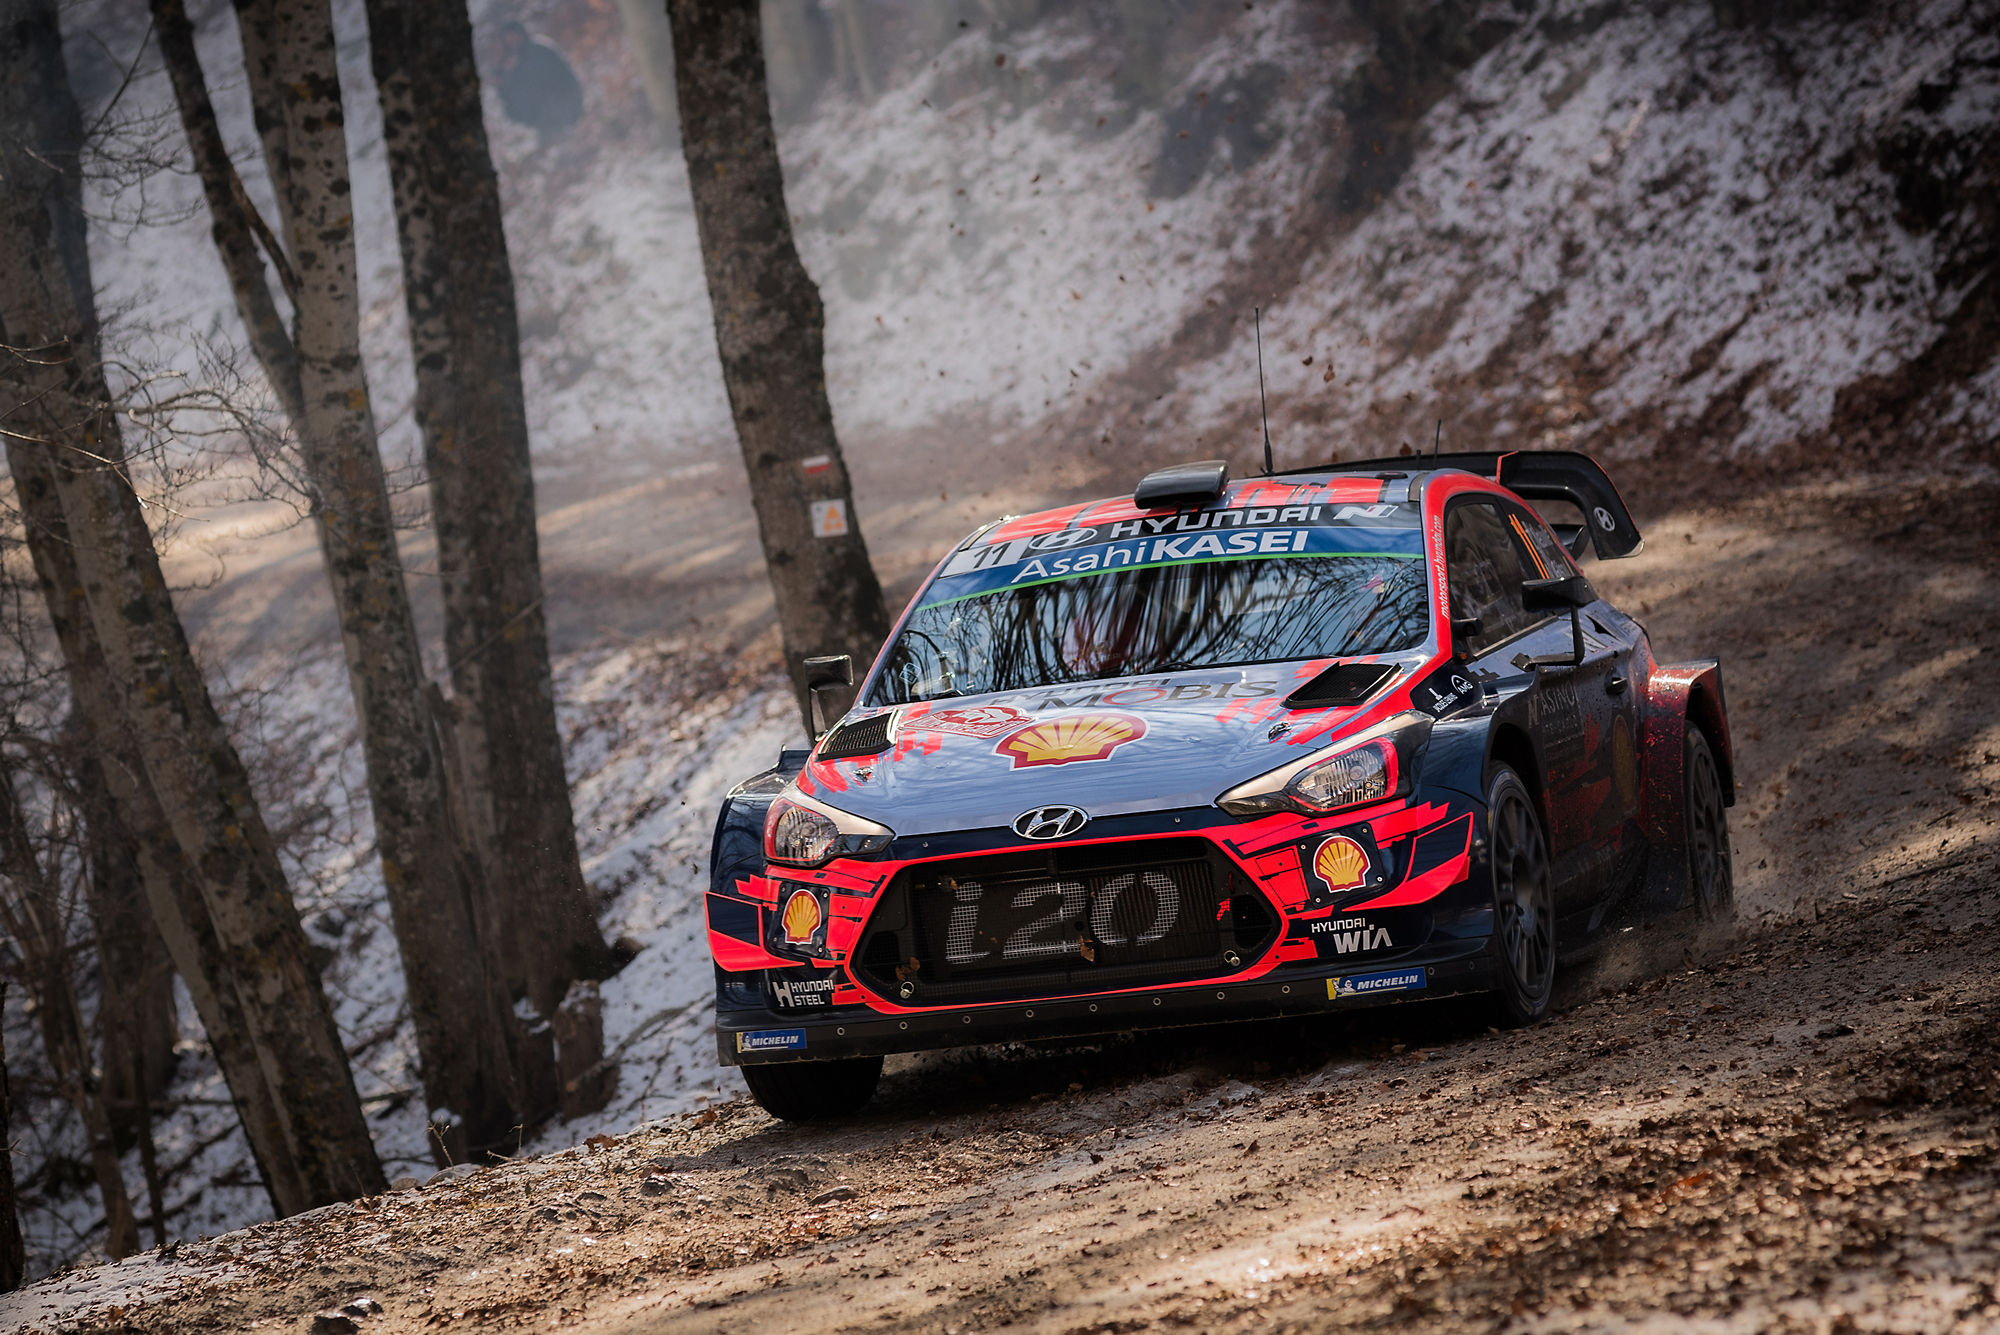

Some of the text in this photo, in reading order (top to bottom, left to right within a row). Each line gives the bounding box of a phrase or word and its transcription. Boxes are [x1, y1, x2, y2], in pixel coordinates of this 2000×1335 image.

[1110, 505, 1322, 539] HYUNDAI
[973, 541, 1013, 569] 11
[1431, 514, 1450, 620] motorsport.hyundai.com
[990, 678, 1172, 706] HYUNDAI
[1036, 680, 1278, 713] MOBIS
[1540, 680, 1576, 717] ASINO
[945, 871, 1180, 965] i20
[1311, 917, 1366, 934] HYUNDAI
[790, 979, 835, 993] HYUNDAI
[1357, 974, 1419, 990] MICHELIN
[794, 994, 826, 1006] STEEL
[751, 1035, 799, 1047] MICHELIN
